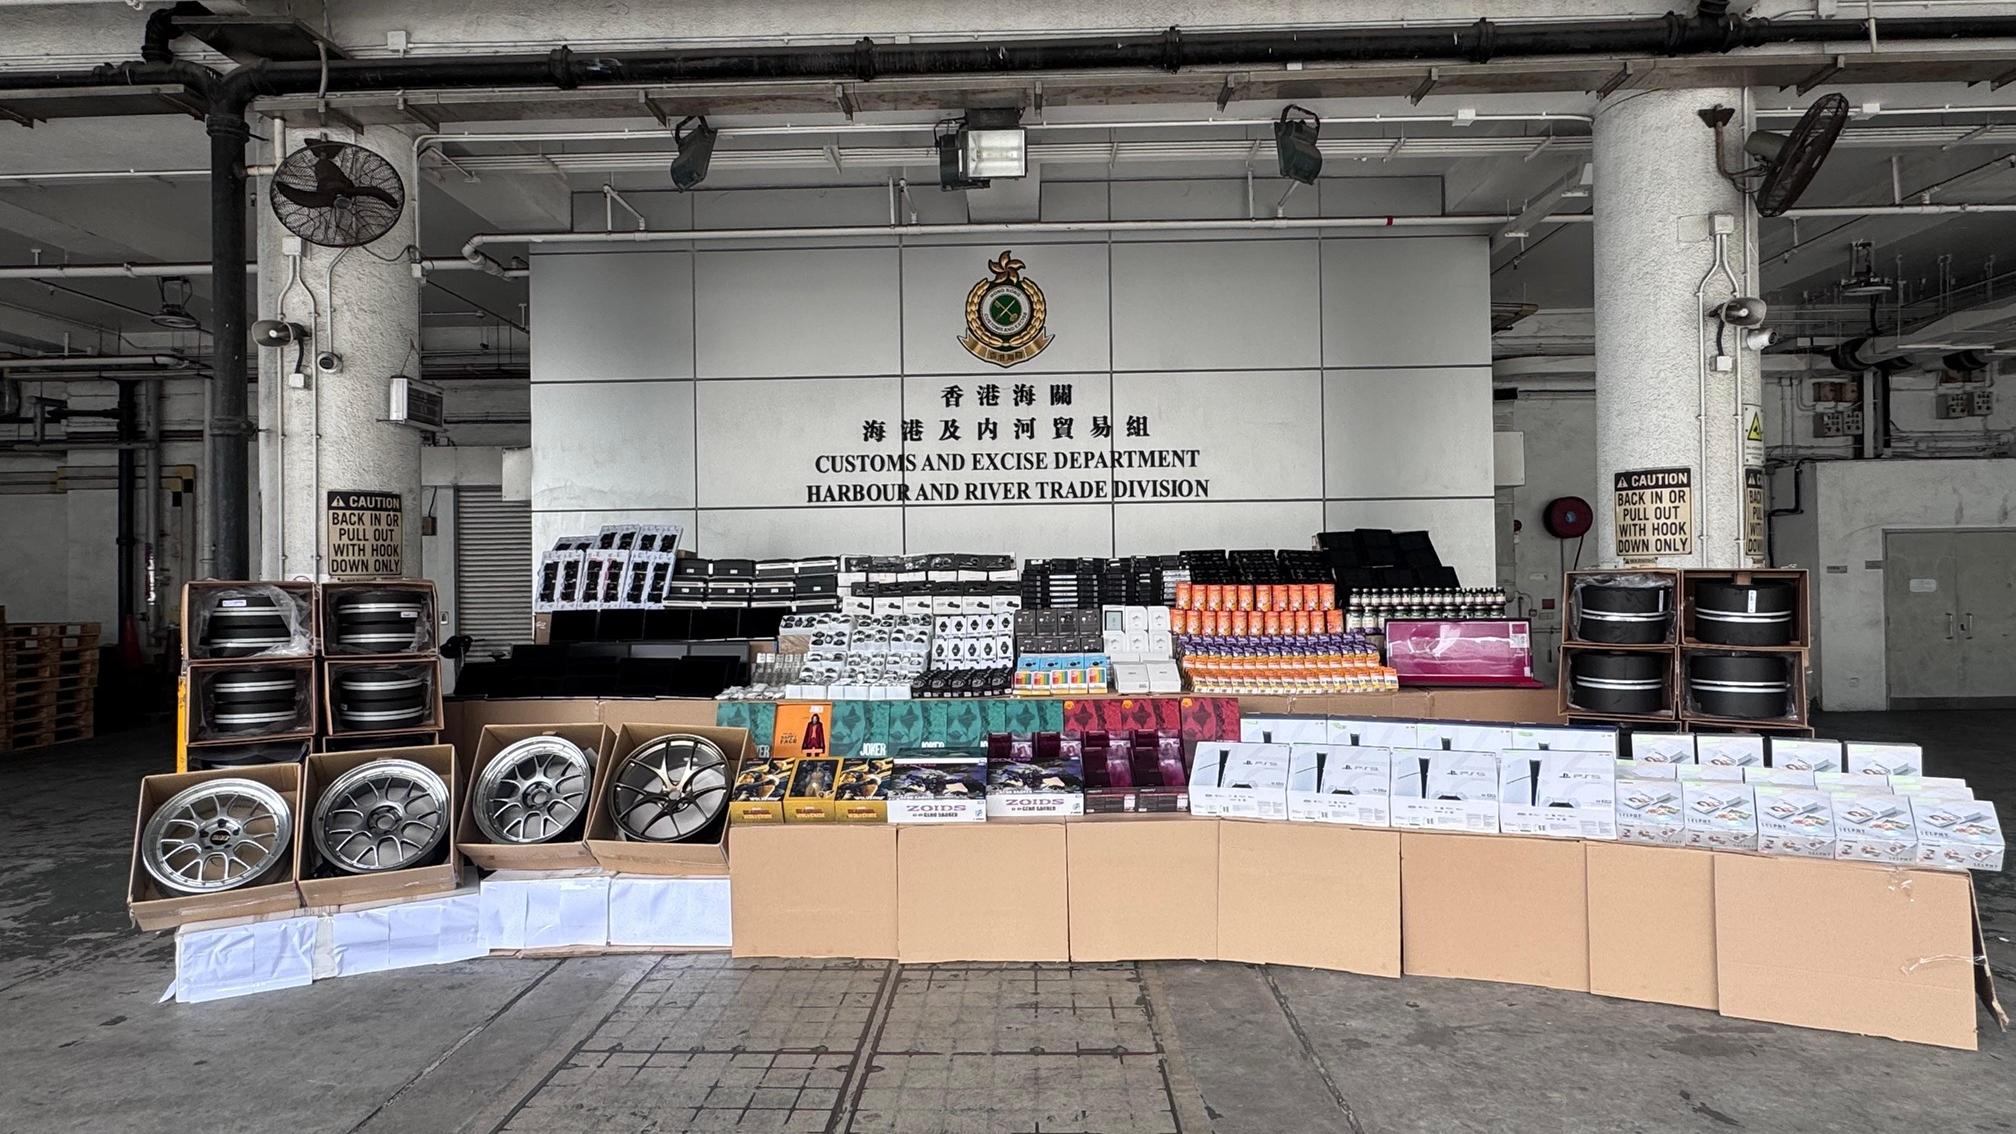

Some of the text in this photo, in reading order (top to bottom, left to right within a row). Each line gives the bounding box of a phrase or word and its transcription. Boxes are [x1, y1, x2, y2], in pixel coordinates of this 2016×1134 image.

[941, 384, 1073, 408] 香港海關
[815, 450, 1200, 473] CUSTOMS AND EXCISE DEPARTMENT
[1631, 472, 1688, 487] CAUTION
[806, 479, 1210, 503] HARBOUR AND RIVER TRADE DIVISION
[1617, 489, 1686, 507] BACK IN OR
[349, 496, 400, 509] CAUTION
[332, 512, 399, 527] BACK IN OR
[1623, 506, 1680, 522] PULL OUT
[339, 528, 395, 542] PULL OUT
[1619, 522, 1687, 538] WITH HOOK
[333, 544, 399, 557] WITH HOOK
[1618, 537, 1688, 553] DOWN ONLY
[331, 559, 400, 573] DOWN ONLY
[860, 742, 887, 756] JOKER
[906, 804, 966, 812] ZOIDS
[1005, 798, 1065, 806] ZOIDS
